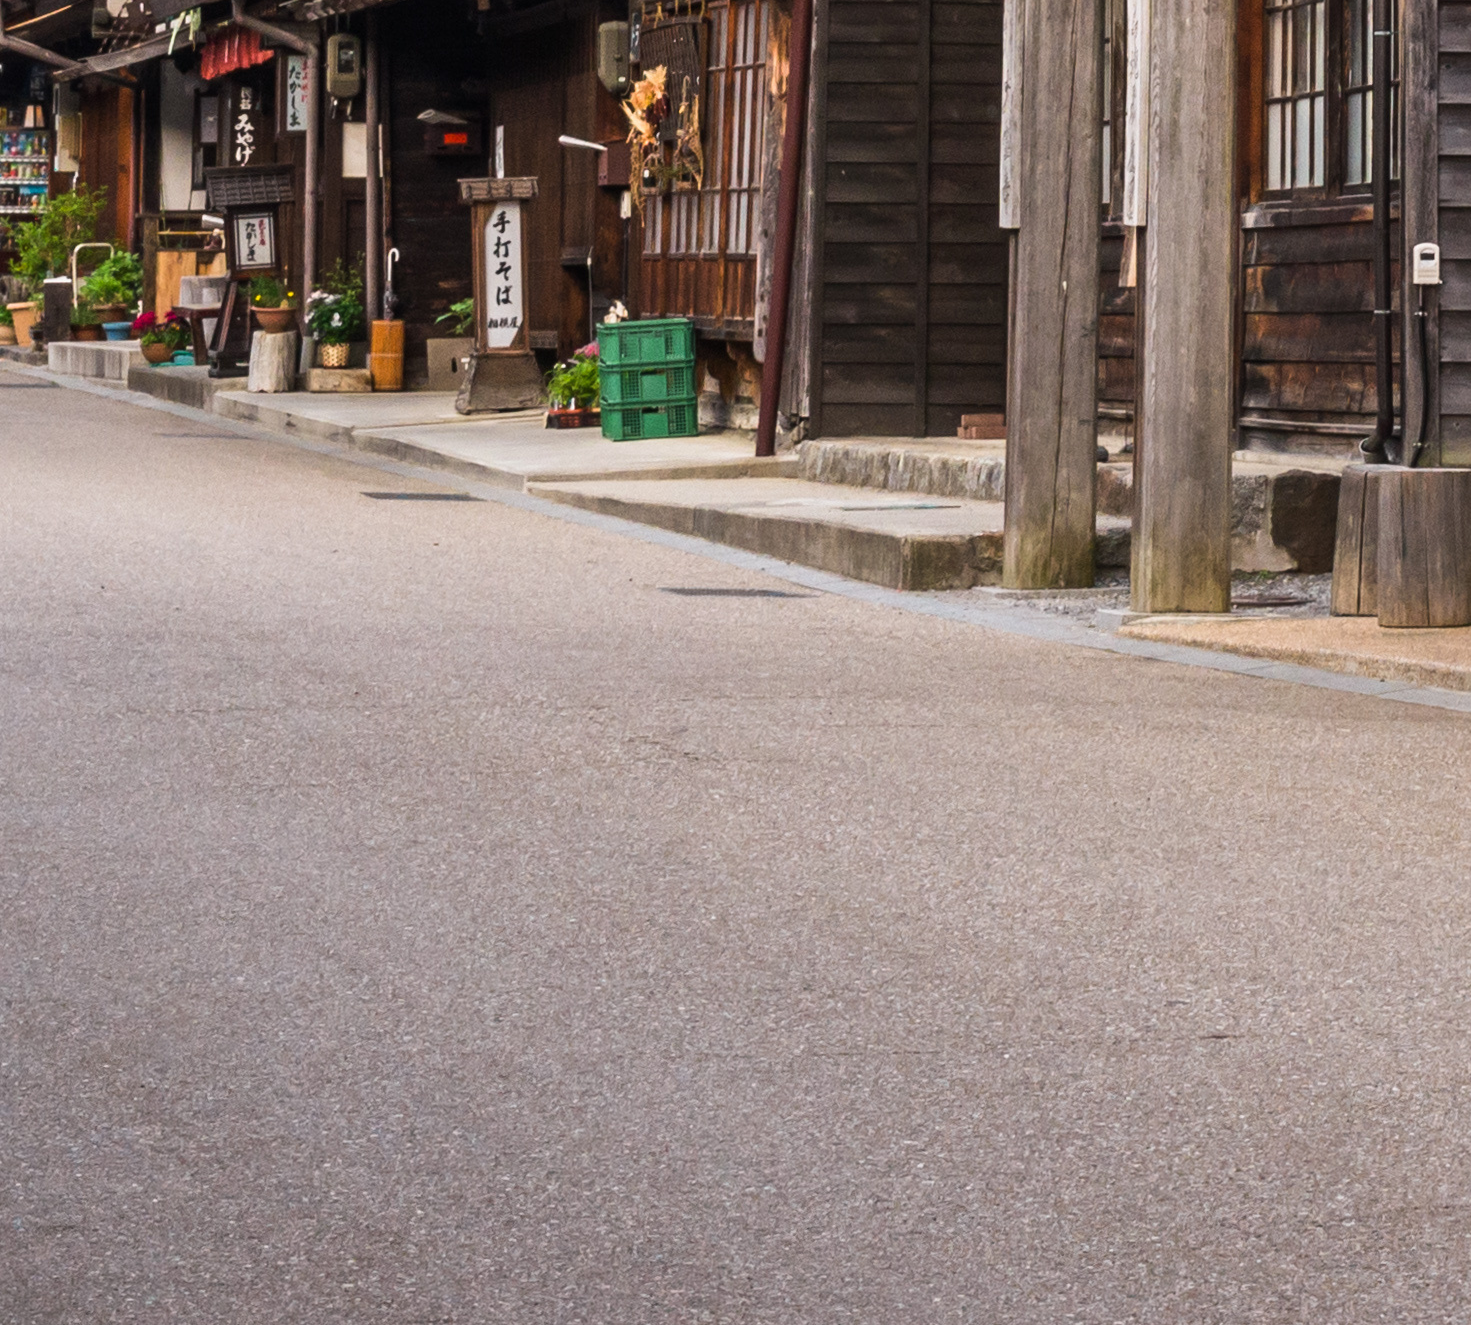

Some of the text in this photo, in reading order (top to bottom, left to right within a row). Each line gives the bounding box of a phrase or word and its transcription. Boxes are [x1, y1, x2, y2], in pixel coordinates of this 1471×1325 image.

[289, 65, 301, 127] たかしま
[493, 210, 513, 306] 手打そば
